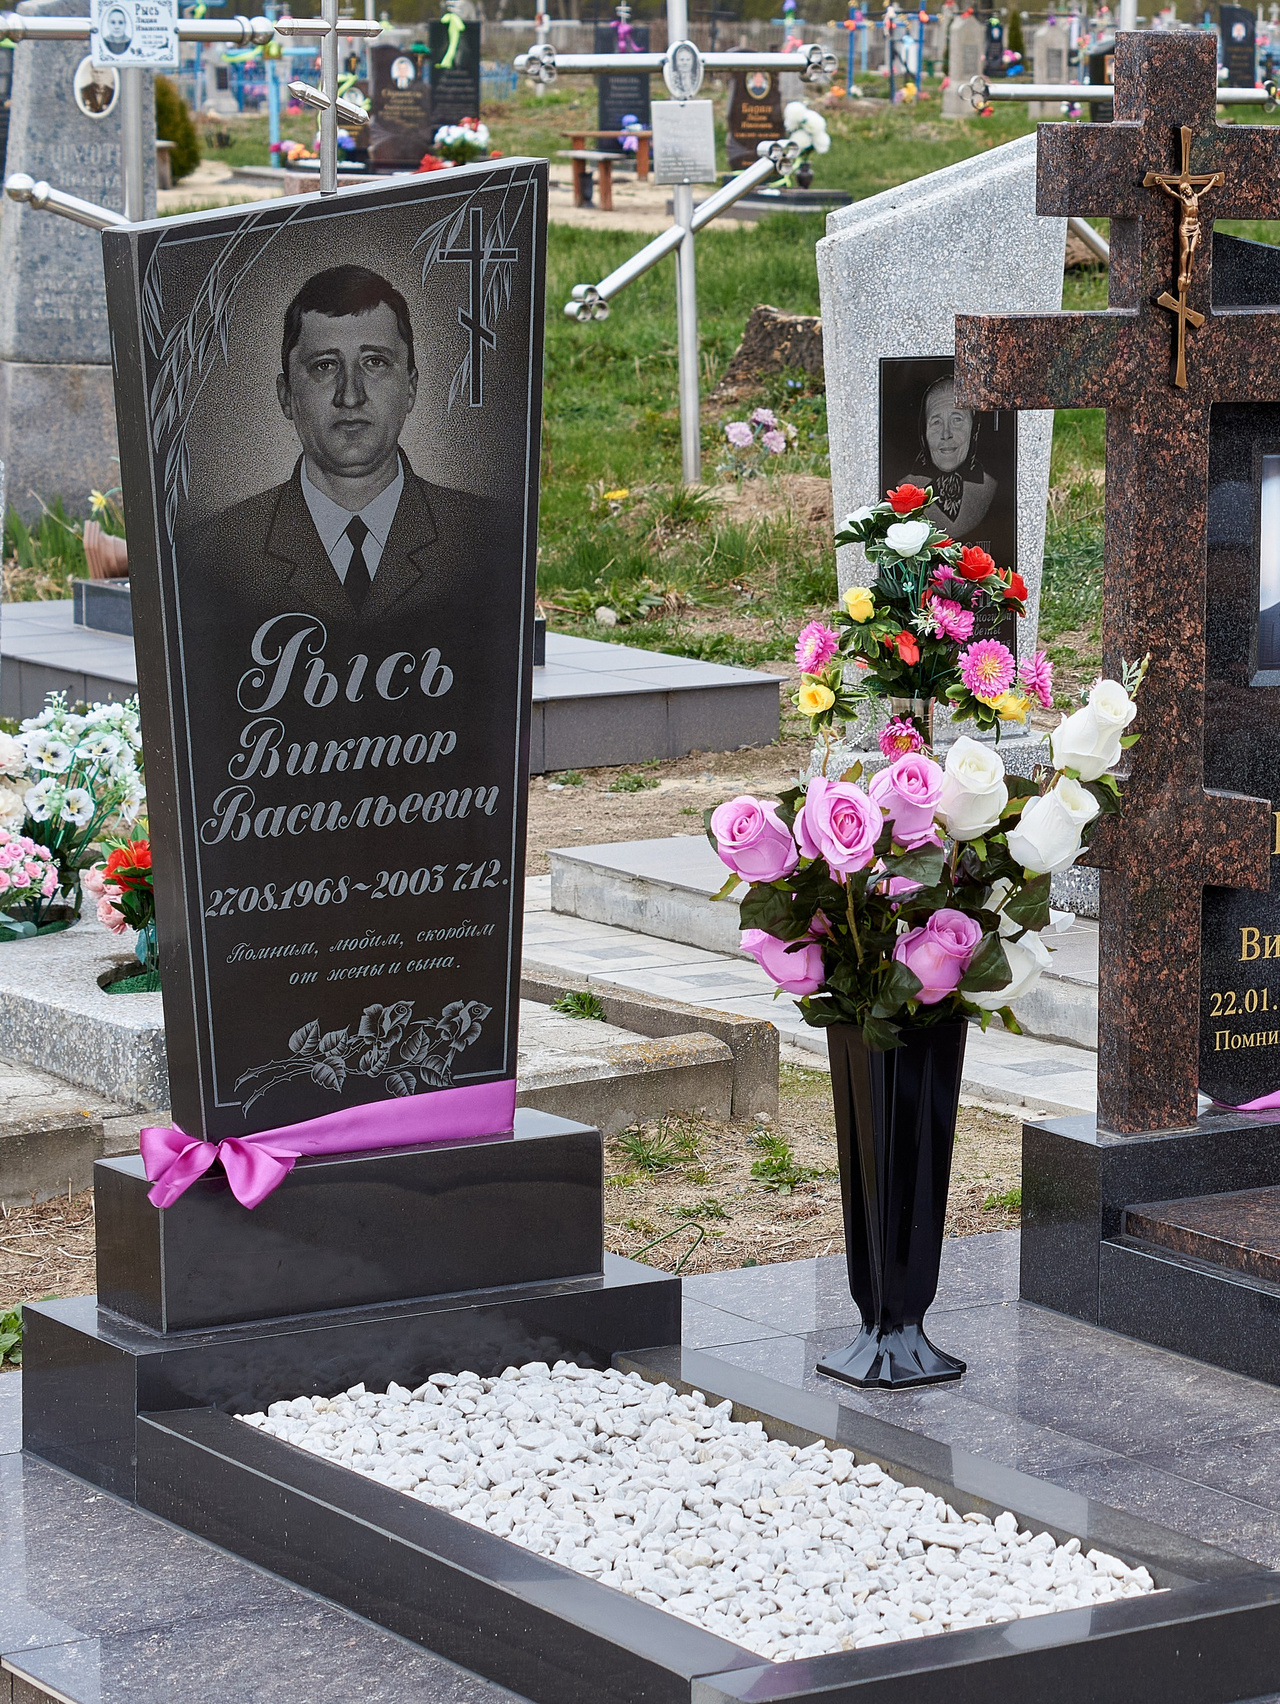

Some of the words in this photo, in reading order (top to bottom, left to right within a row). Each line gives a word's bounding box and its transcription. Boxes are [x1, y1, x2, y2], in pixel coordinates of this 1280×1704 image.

[135, 3, 159, 15] Рысь
[237, 613, 454, 713] Рысь
[228, 717, 458, 782] Виктор
[200, 783, 500, 846] Васильевич
[226, 941, 320, 964] Помним,
[329, 929, 404, 953] любим,
[416, 919, 496, 942] скорбим
[288, 969, 317, 986] от
[326, 964, 384, 983] жены
[388, 961, 402, 974] и
